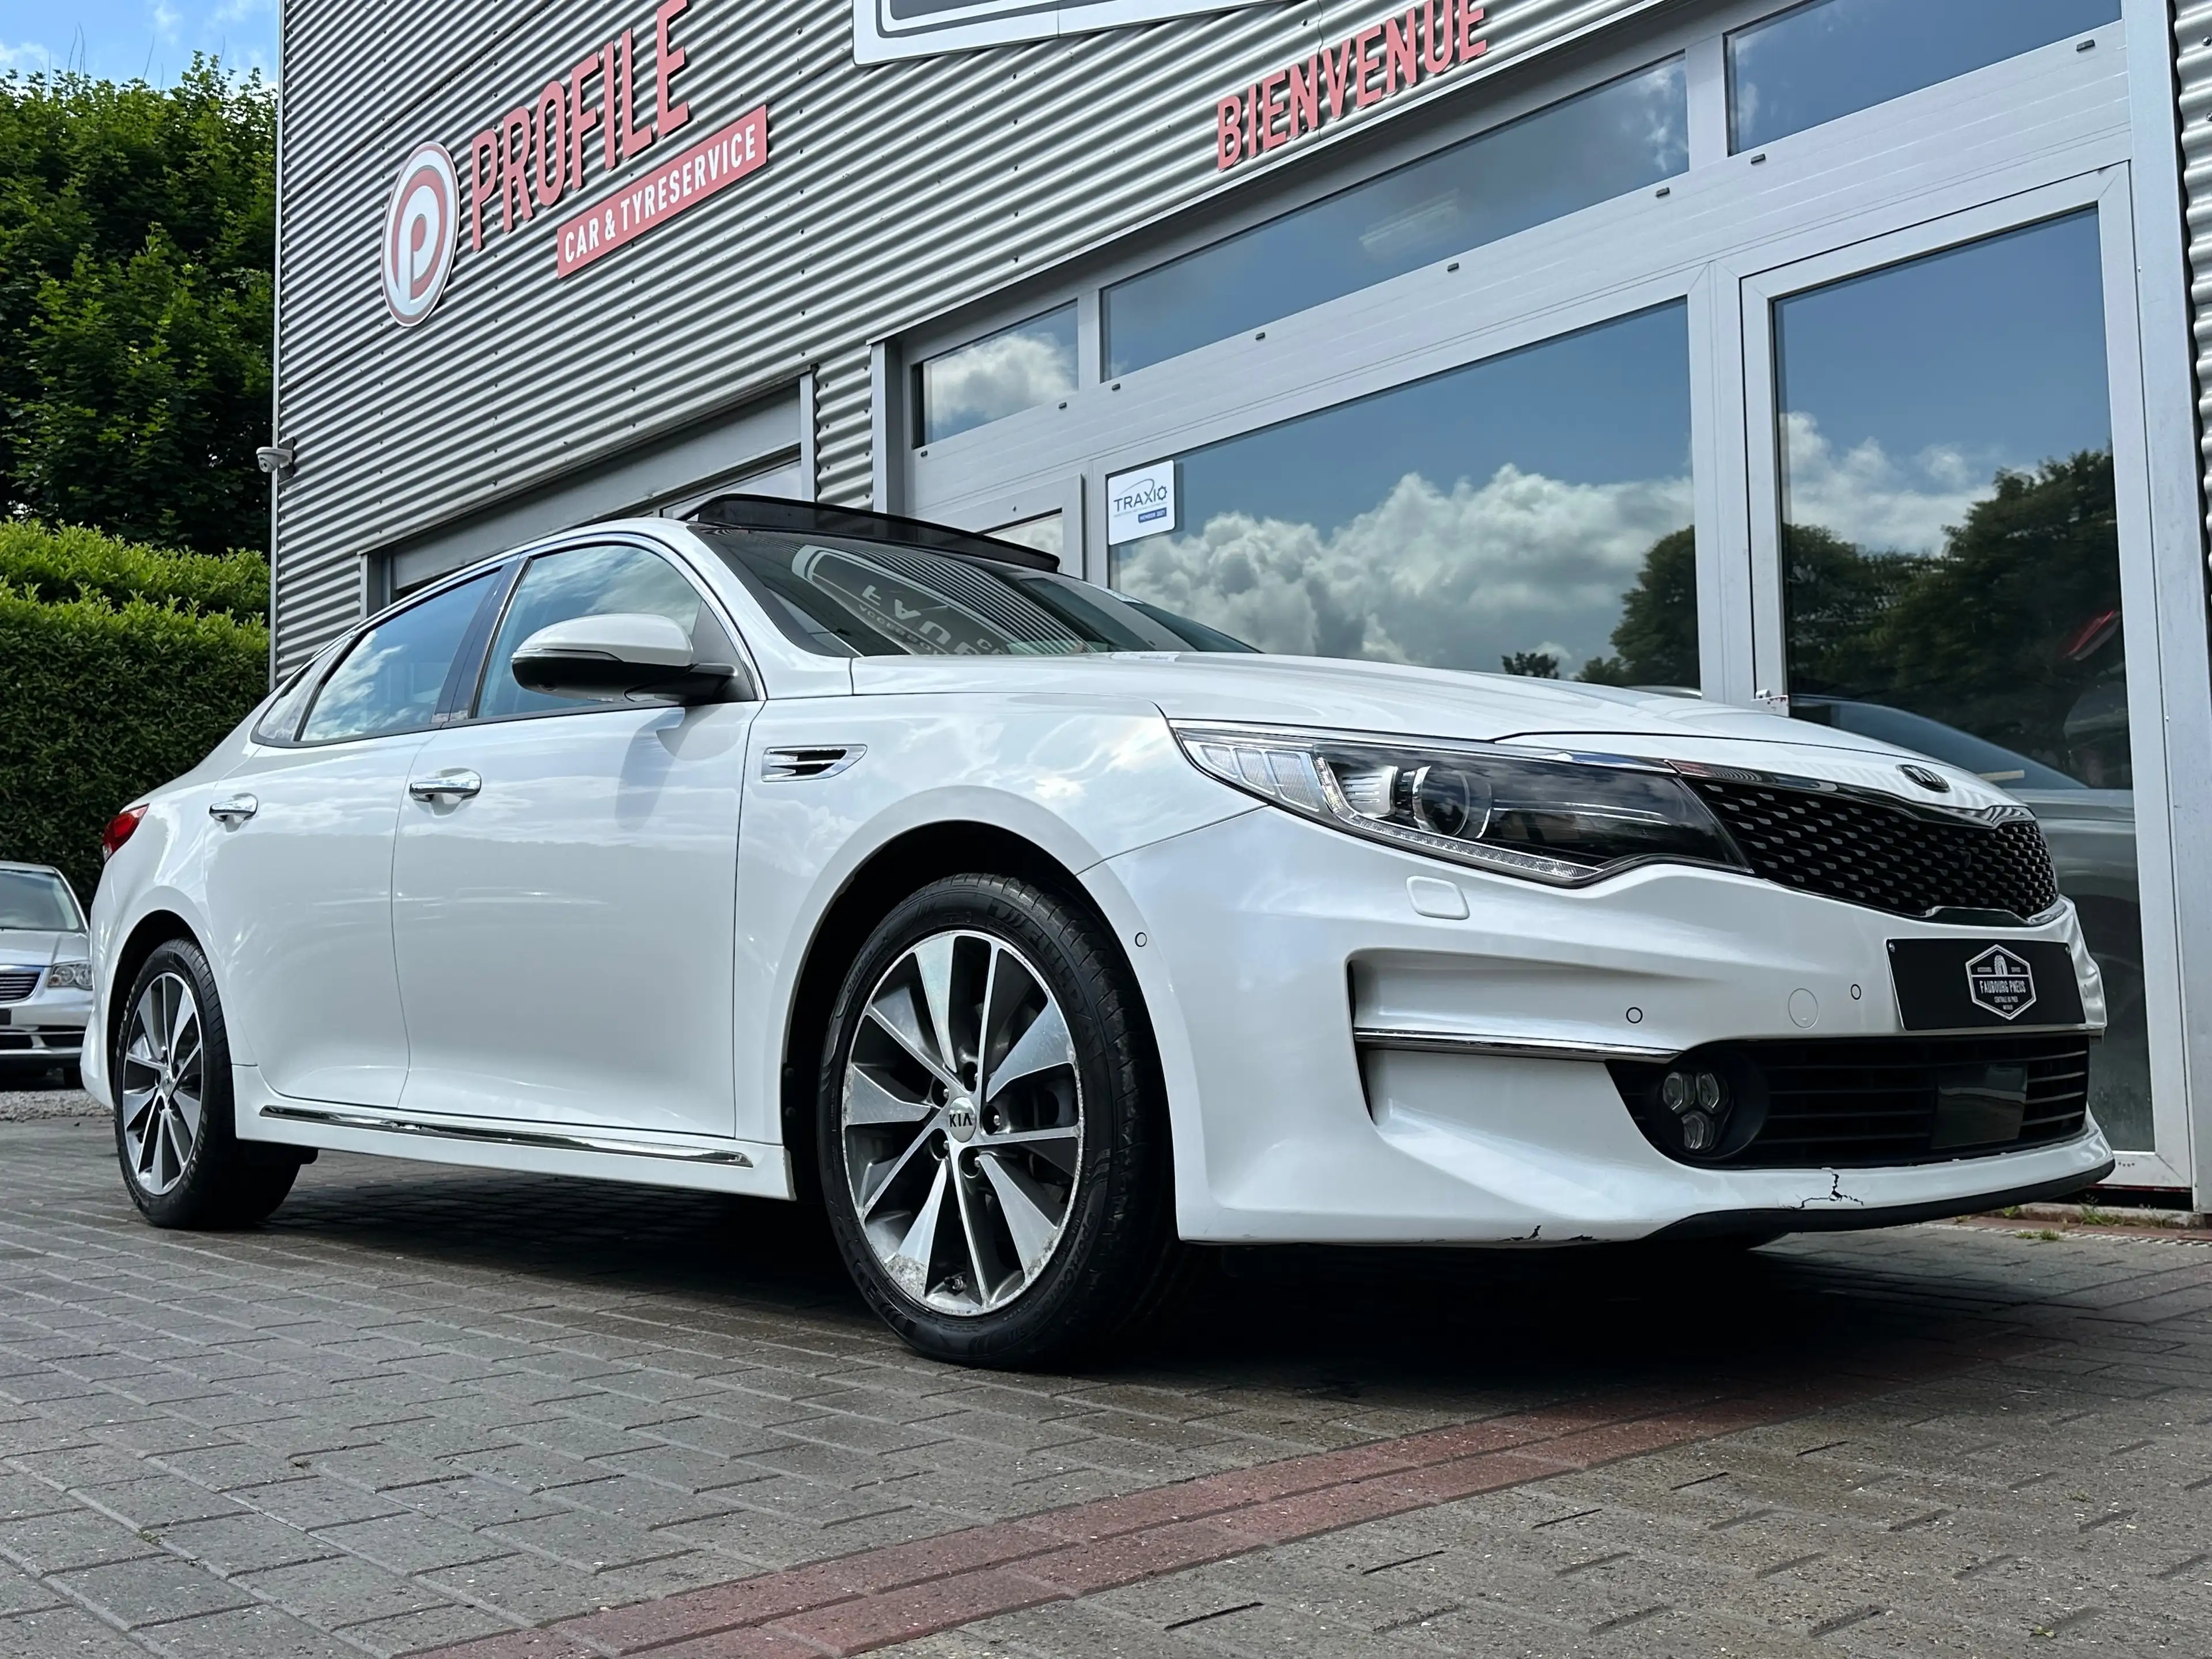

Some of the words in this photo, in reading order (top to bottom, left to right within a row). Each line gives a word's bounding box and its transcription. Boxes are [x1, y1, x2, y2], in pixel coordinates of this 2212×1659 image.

[472, 0, 688, 252] PROFILE
[1217, 0, 1487, 172] BIENVENUE
[565, 217, 600, 263] CAR
[604, 208, 616, 241] &
[620, 123, 756, 232] TYRESERVICE
[1113, 485, 1168, 512] TRAXIO
[949, 1112, 973, 1128] KIA
